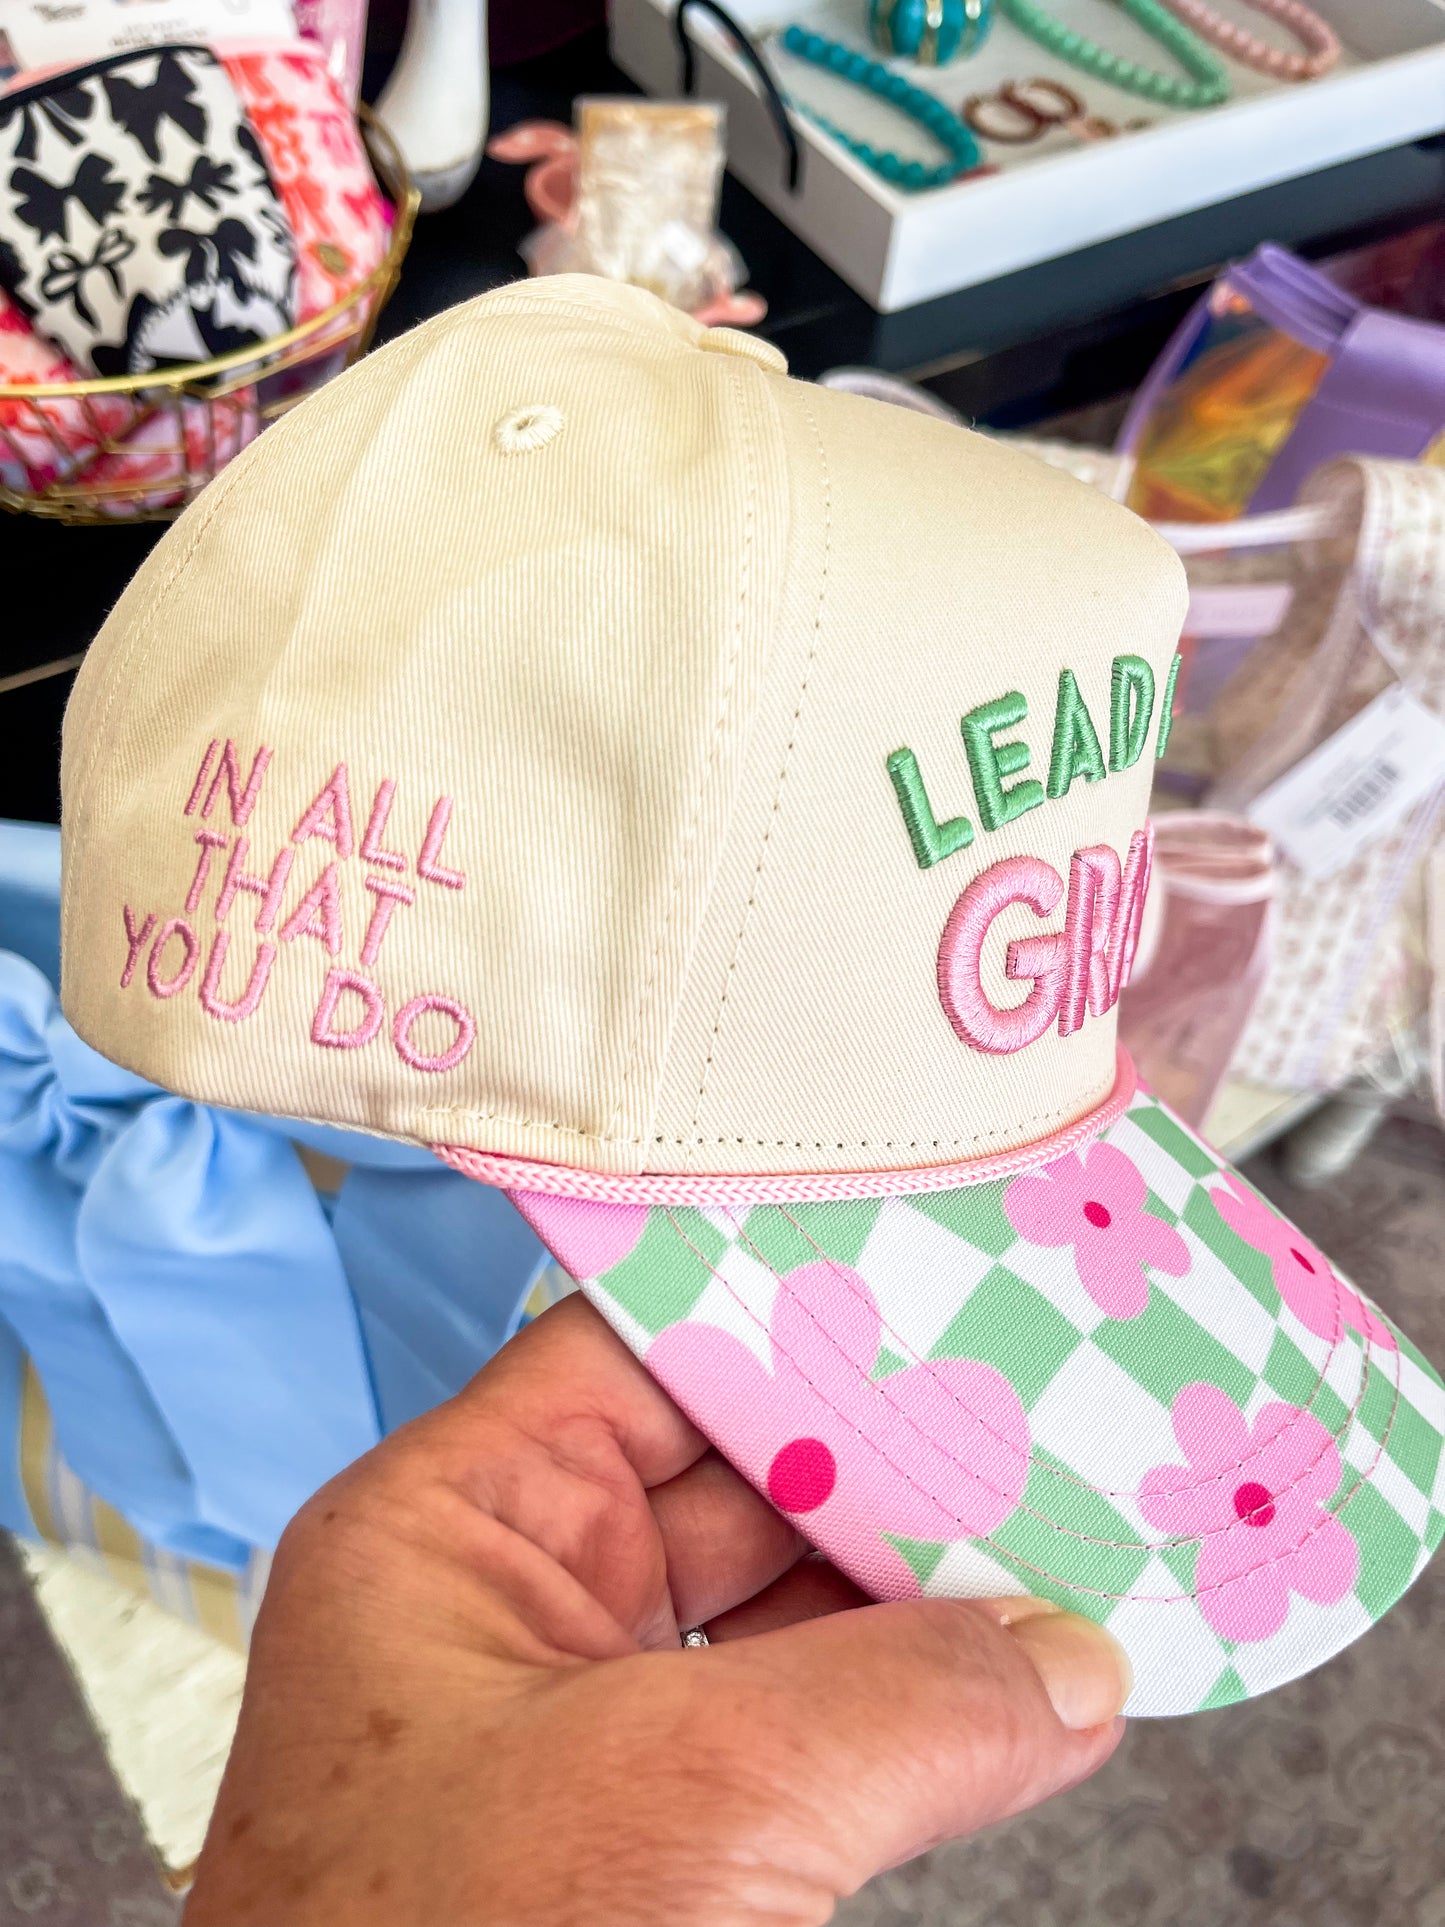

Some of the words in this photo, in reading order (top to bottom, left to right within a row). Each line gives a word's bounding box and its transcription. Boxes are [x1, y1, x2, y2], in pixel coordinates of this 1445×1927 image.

[185, 739, 273, 827] IN
[291, 762, 466, 890] ALL
[185, 829, 416, 966] THAT
[120, 904, 277, 1024] YOU
[312, 967, 477, 1073] DO
